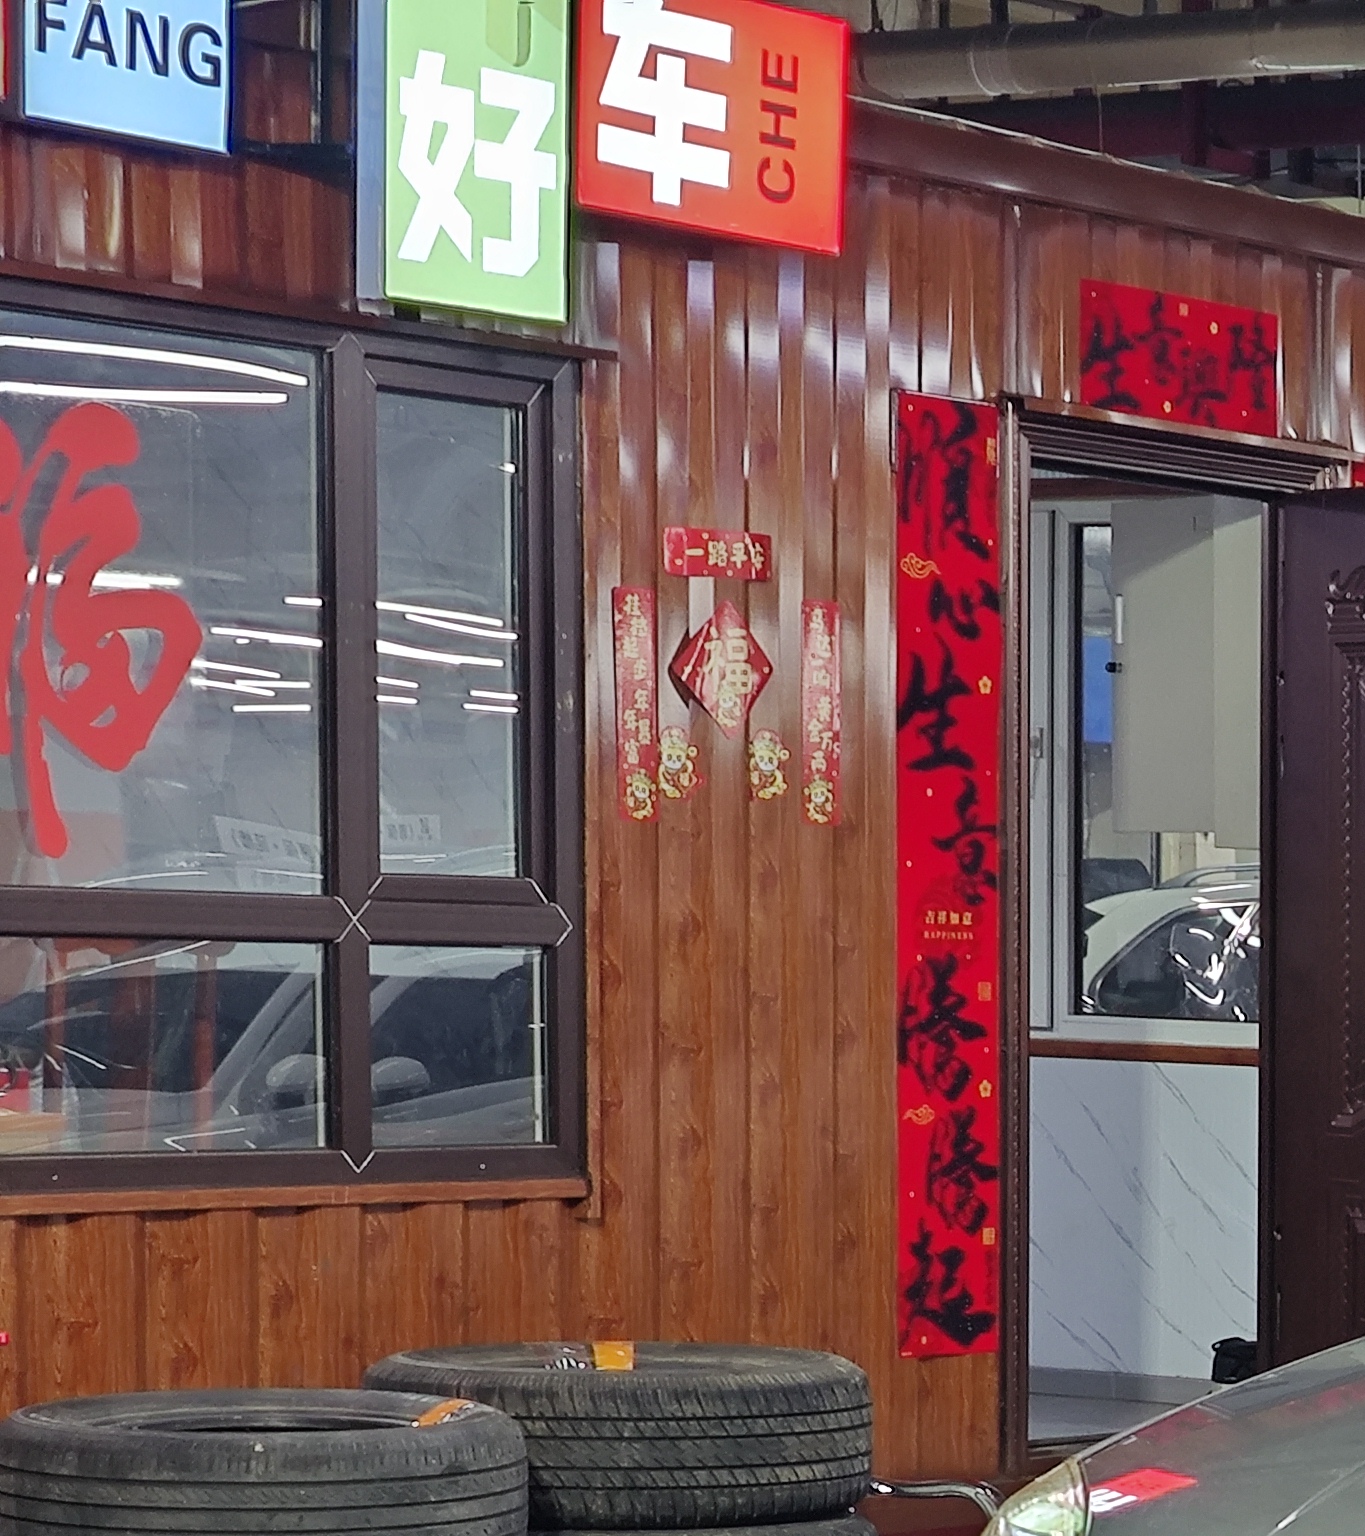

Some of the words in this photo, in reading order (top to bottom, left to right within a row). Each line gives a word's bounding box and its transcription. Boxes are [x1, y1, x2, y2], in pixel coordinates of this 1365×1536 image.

[34, 0, 222, 88] FANG
[597, 0, 734, 207] 车
[396, 48, 558, 279] 好
[756, 48, 799, 204] CHE
[684, 538, 766, 571] 一路平安
